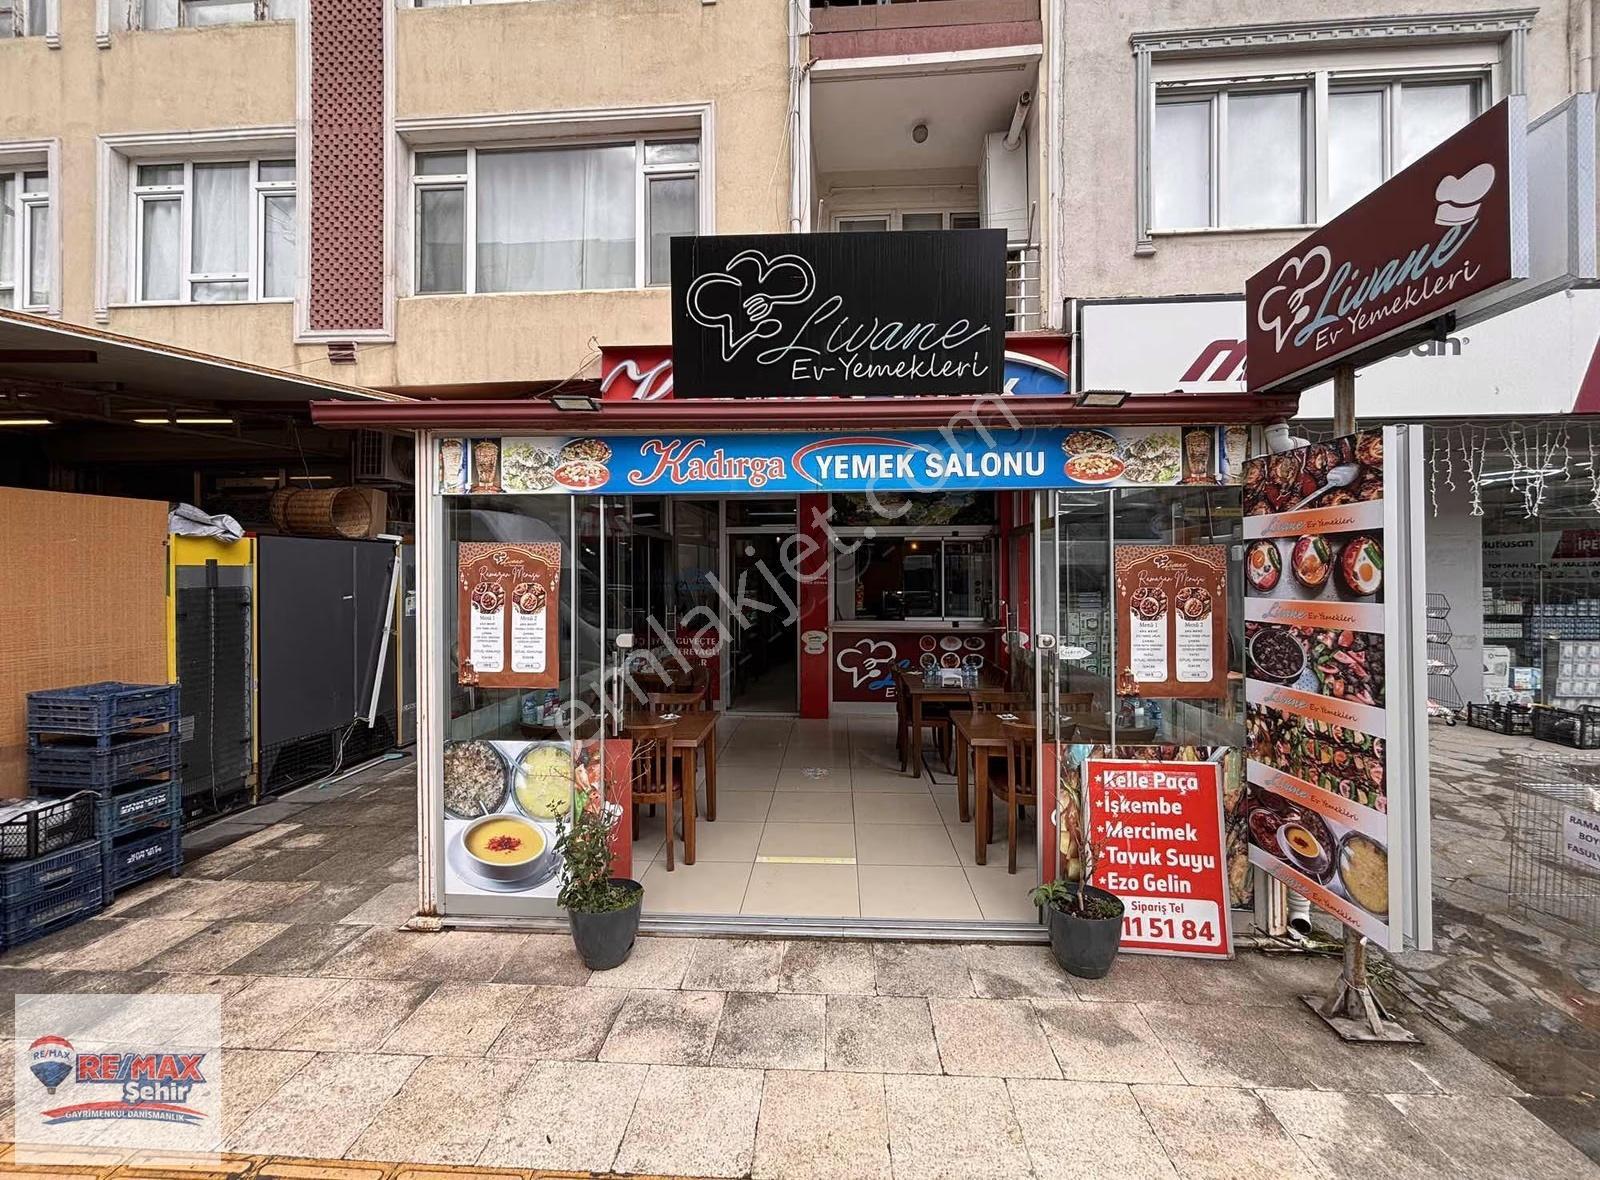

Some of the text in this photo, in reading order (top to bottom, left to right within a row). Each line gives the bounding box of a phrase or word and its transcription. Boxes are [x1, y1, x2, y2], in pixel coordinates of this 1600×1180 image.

[1294, 220, 1478, 346] Livane
[1315, 259, 1481, 351] Ev Yemekleri
[756, 295, 991, 364] Livane
[791, 351, 988, 381] Ev Yemekleri
[627, 439, 1045, 488] Kadırga YEMEK SALONU
[1103, 770, 1198, 795] Kelle Paça
[1104, 790, 1183, 818] İşkembe
[1105, 820, 1198, 842] Mercimek
[1105, 846, 1215, 873] Tavuk Suyu
[1107, 871, 1192, 894] Ezo Gelin
[1131, 901, 1184, 915] Sipariş Tel
[1149, 917, 1175, 939] 51
[1181, 919, 1215, 942] 84
